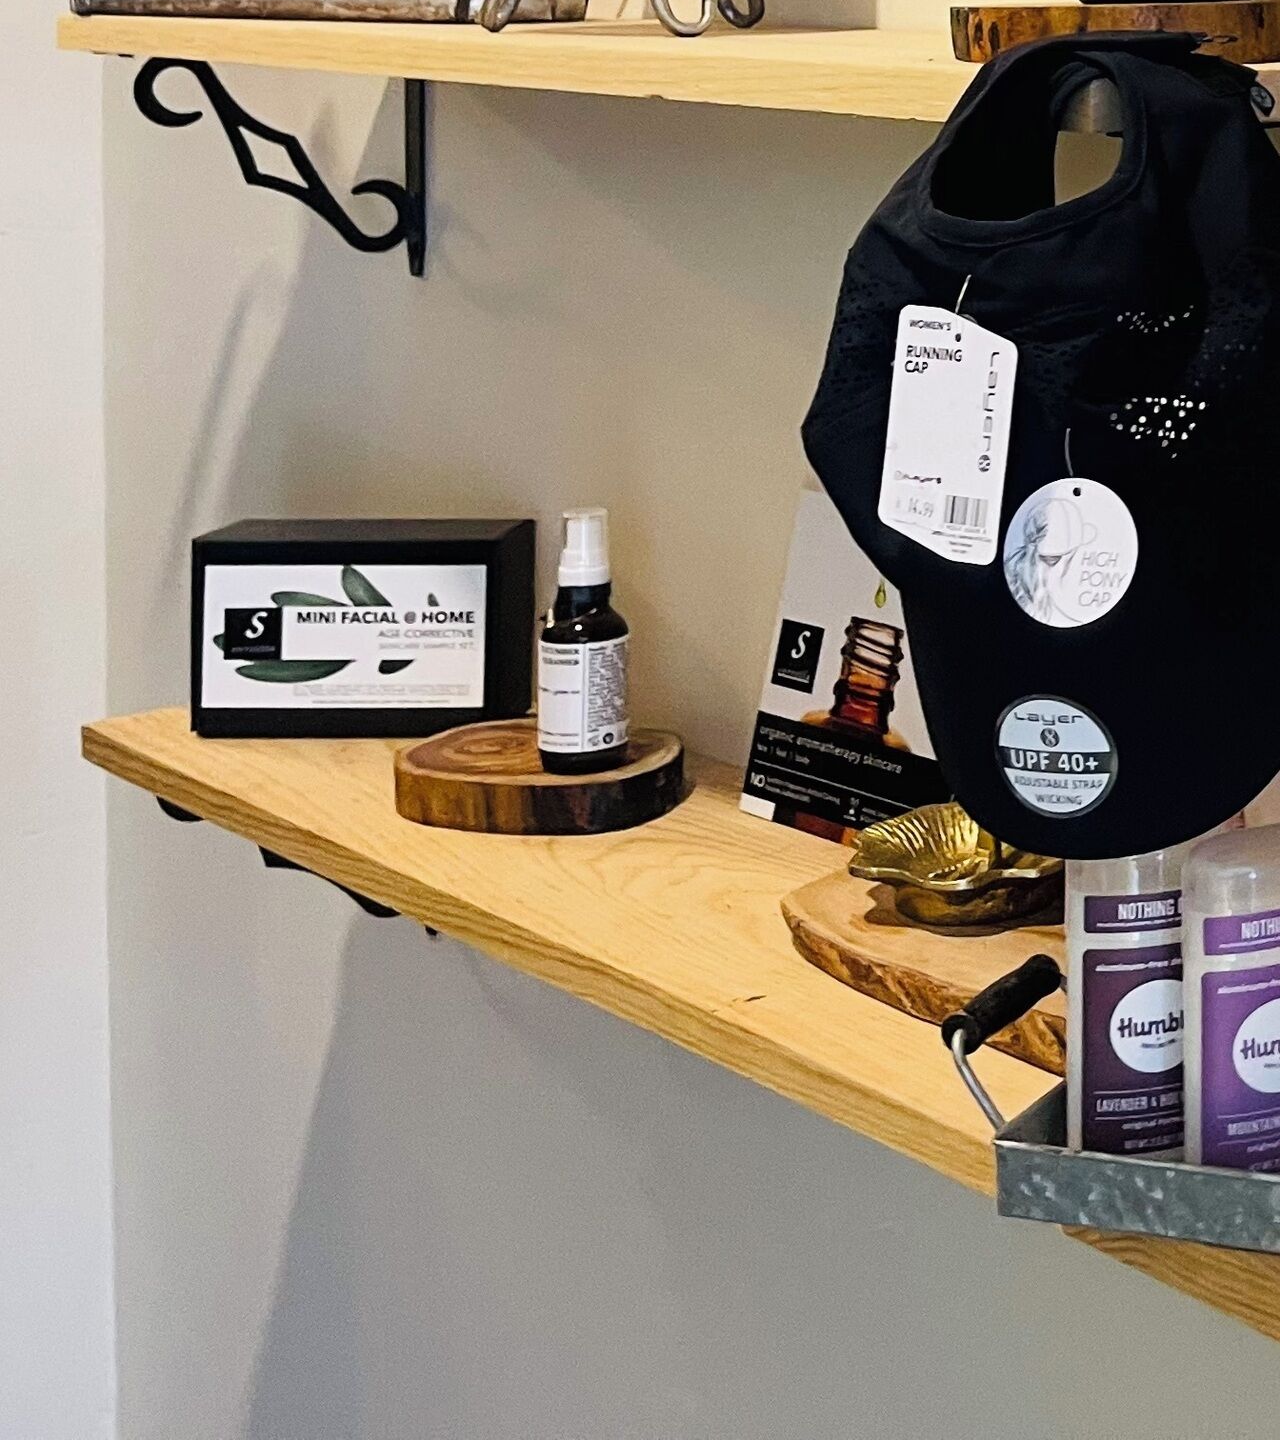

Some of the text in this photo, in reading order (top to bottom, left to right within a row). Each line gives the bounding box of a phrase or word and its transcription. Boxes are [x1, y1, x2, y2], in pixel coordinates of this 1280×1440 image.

[906, 345, 963, 362] RUNNING
[905, 360, 929, 374] CAP
[1081, 551, 1119, 568] HIGH
[1079, 570, 1128, 588] PONY
[1078, 591, 1112, 607] CAP
[297, 611, 336, 624] MINI
[341, 611, 400, 624] FACIAL
[421, 611, 475, 624] HOME
[1010, 749, 1099, 772] UPF 40+
[1118, 899, 1175, 920] NOTHING
[1118, 1010, 1184, 1038] Humbl
